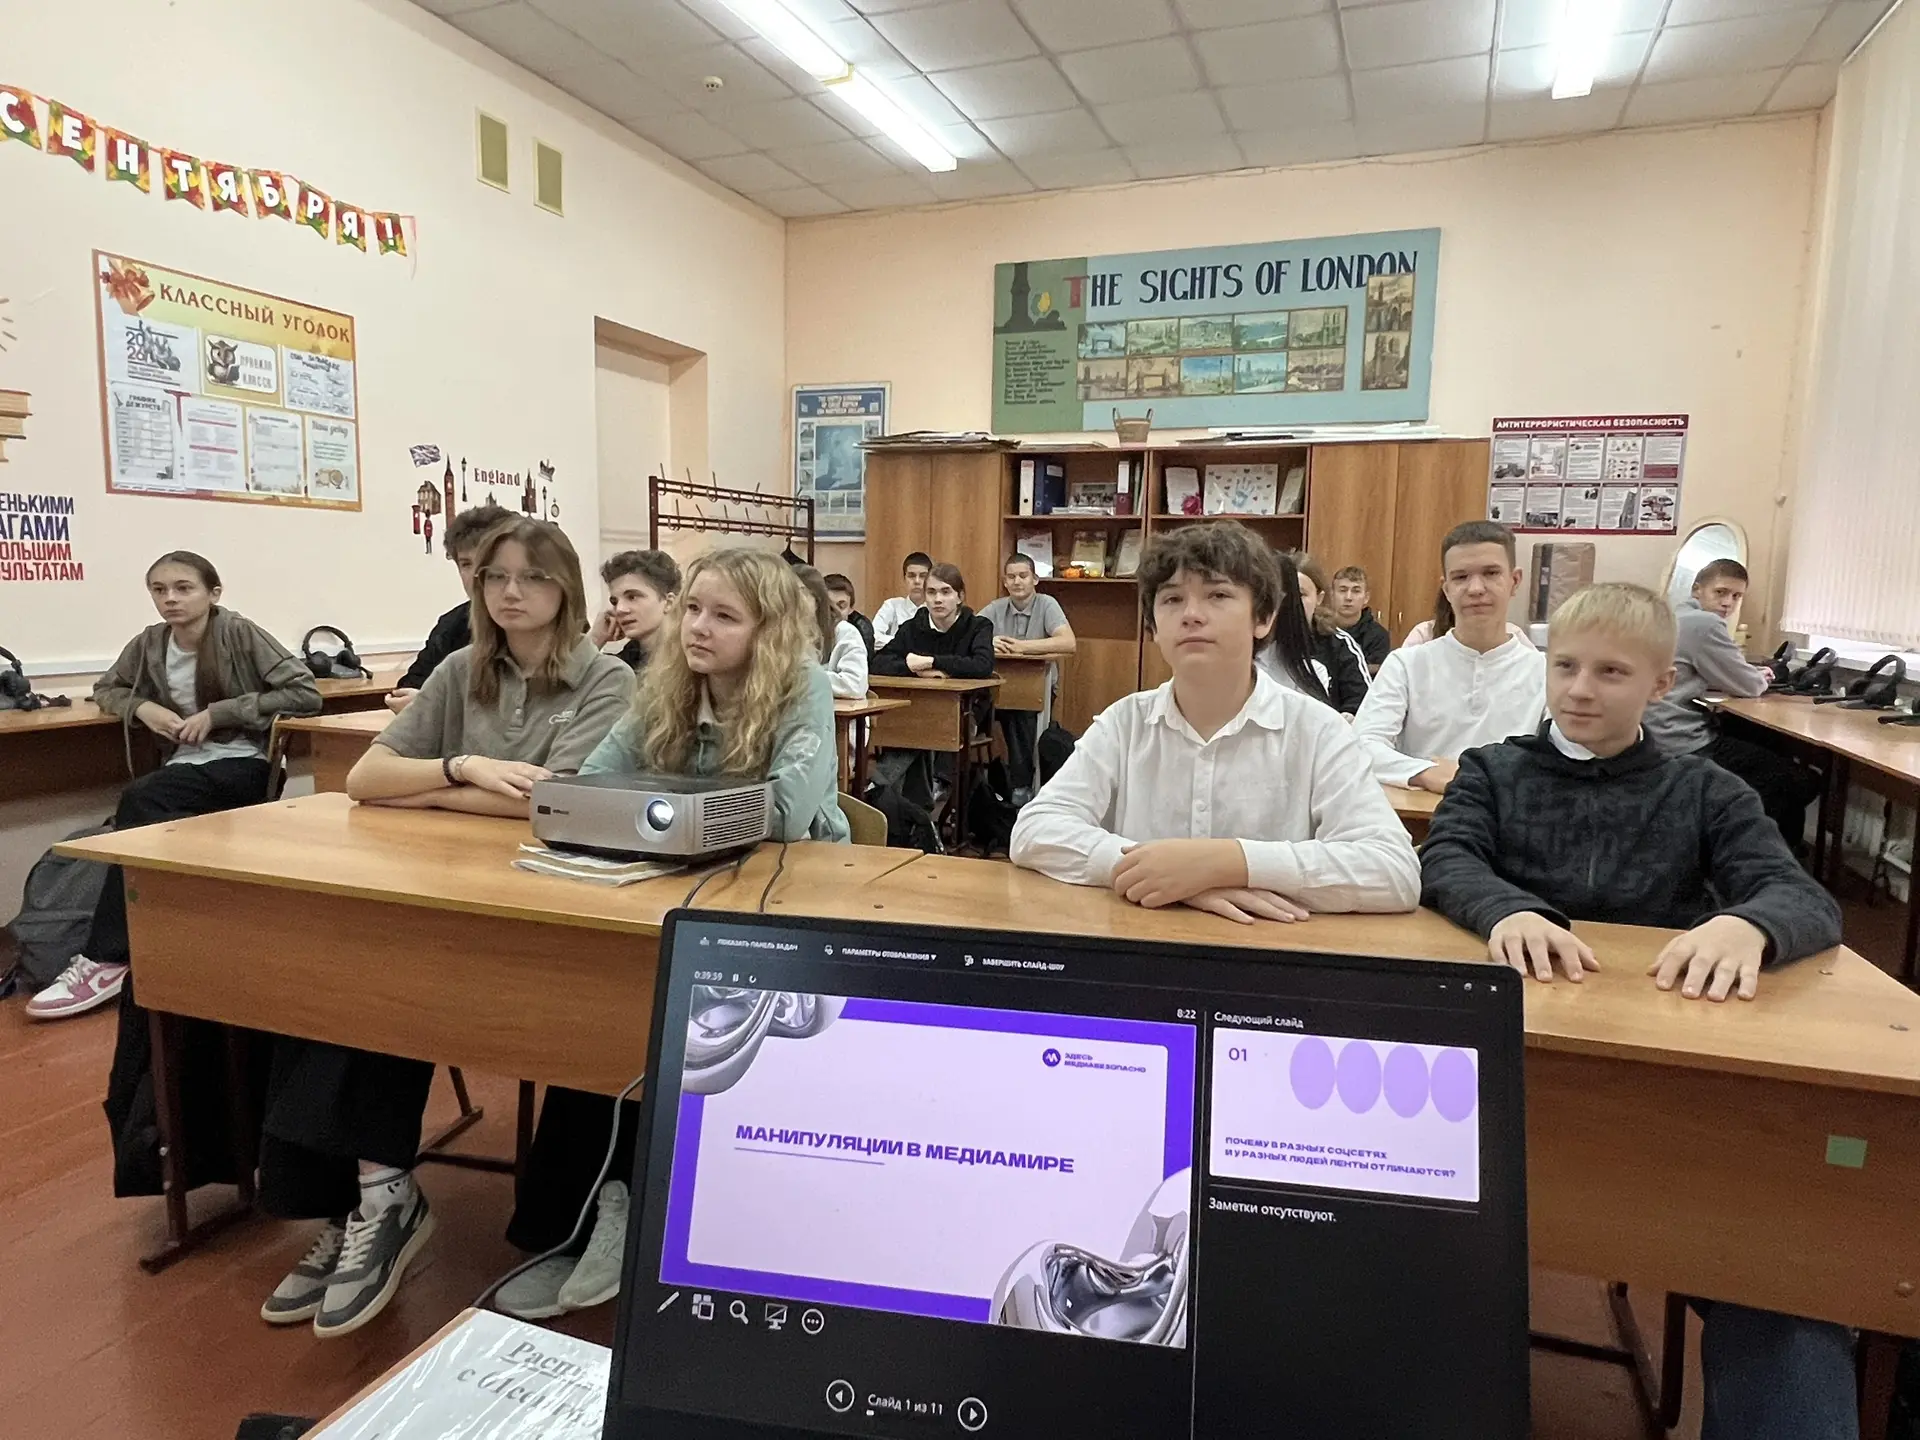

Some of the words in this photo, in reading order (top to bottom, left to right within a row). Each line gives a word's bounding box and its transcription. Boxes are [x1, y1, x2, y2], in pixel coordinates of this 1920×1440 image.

[1063, 273, 1123, 309] THE
[1139, 263, 1243, 304] SIGHTS
[1255, 259, 1291, 296] OF
[159, 282, 275, 326] КЛАССНЫЙ
[282, 313, 351, 344] УГОЛОК
[1496, 418, 1612, 430] АНТИТЕРРОРИСТИЧЕСКАЯ
[1613, 417, 1685, 428] БЕЗОПАСНОСТЬ
[474, 467, 521, 487] England
[1022, 960, 1065, 972] СЛАЙД-ШОУ
[1176, 1008, 1197, 1020] 8:22
[1214, 1011, 1273, 1026] Следующий
[1274, 1017, 1304, 1029] слайд
[1228, 1047, 1248, 1062] 01
[735, 1124, 904, 1156] МАНИПУЛЯЦИИ
[906, 1142, 922, 1157] В
[924, 1143, 1075, 1173] МЕДИАМИРЕ
[1225, 1136, 1270, 1148] ПОЧЕМУ
[1270, 1141, 1278, 1149] В
[1279, 1142, 1326, 1154] РАЗНЫХ
[1327, 1146, 1388, 1160] СОЦСЕТЯХ
[1225, 1149, 1233, 1157] И
[1234, 1149, 1242, 1159] У
[1242, 1150, 1288, 1163] РАЗНЫХ
[1288, 1154, 1328, 1167] ЛЮДЕЙ
[1329, 1159, 1369, 1170] ЛЕНТЫ
[1208, 1197, 1259, 1215] Заметки
[1260, 1204, 1337, 1223] отсутствуют.
[867, 1393, 902, 1412] Слайд
[905, 1399, 911, 1411] 1
[914, 1403, 927, 1413] из
[931, 1402, 943, 1416] 11
